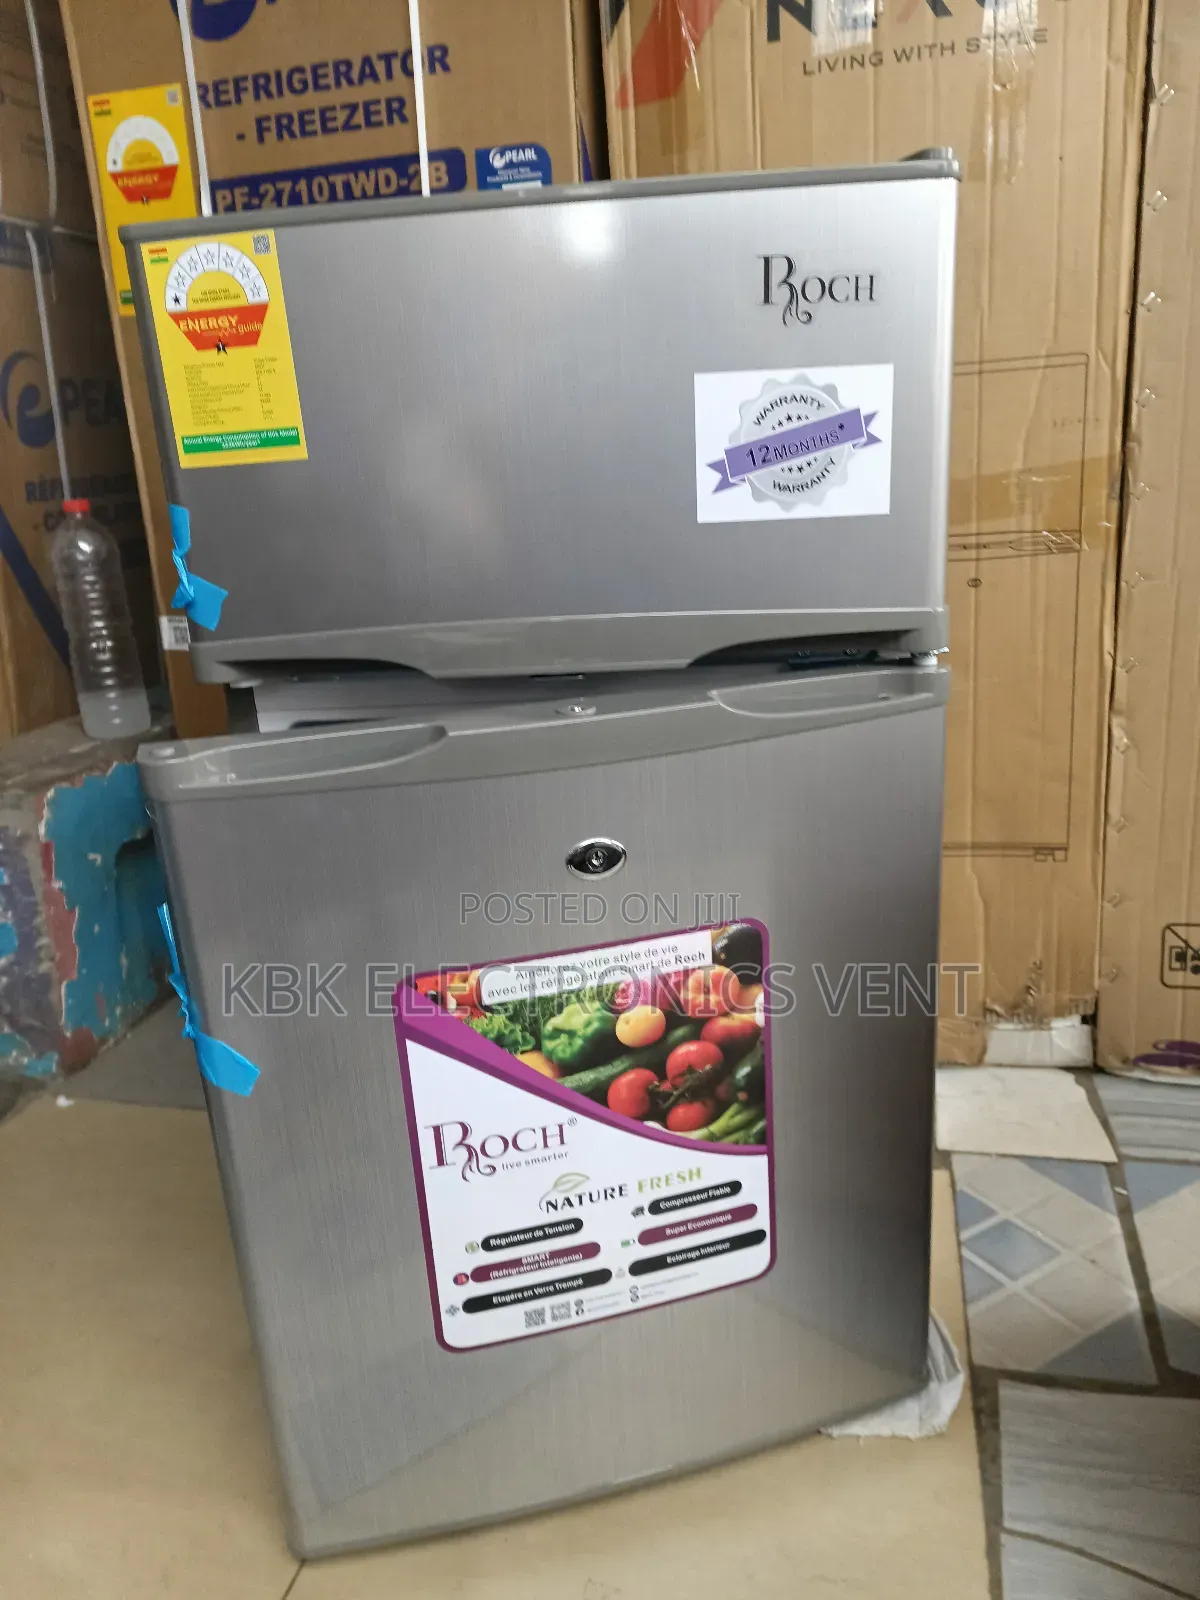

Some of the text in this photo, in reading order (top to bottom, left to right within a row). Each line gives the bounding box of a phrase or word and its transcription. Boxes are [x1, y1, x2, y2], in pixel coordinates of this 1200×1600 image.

[802, 28, 1048, 76] LIVING WITH STYLE
[197, 44, 451, 110] REFRIGERATOR
[254, 96, 409, 144] FREEZER
[505, 147, 538, 163] PEARL
[178, 314, 238, 334] ENERGY
[238, 321, 263, 335] guide
[753, 393, 825, 426] WARRANTY
[772, 455, 836, 493] WARRANTY
[579, 953, 611, 970] votre
[613, 949, 642, 967] style
[644, 946, 658, 959] de
[660, 943, 679, 956] vie
[487, 985, 517, 999] avec
[674, 950, 706, 965] Roch
[501, 1151, 569, 1171] live smarter
[545, 1167, 702, 1214] NATURE FRESH
[533, 1228, 544, 1238] de
[544, 1223, 575, 1235] Tension
[521, 1252, 551, 1265] SMART
